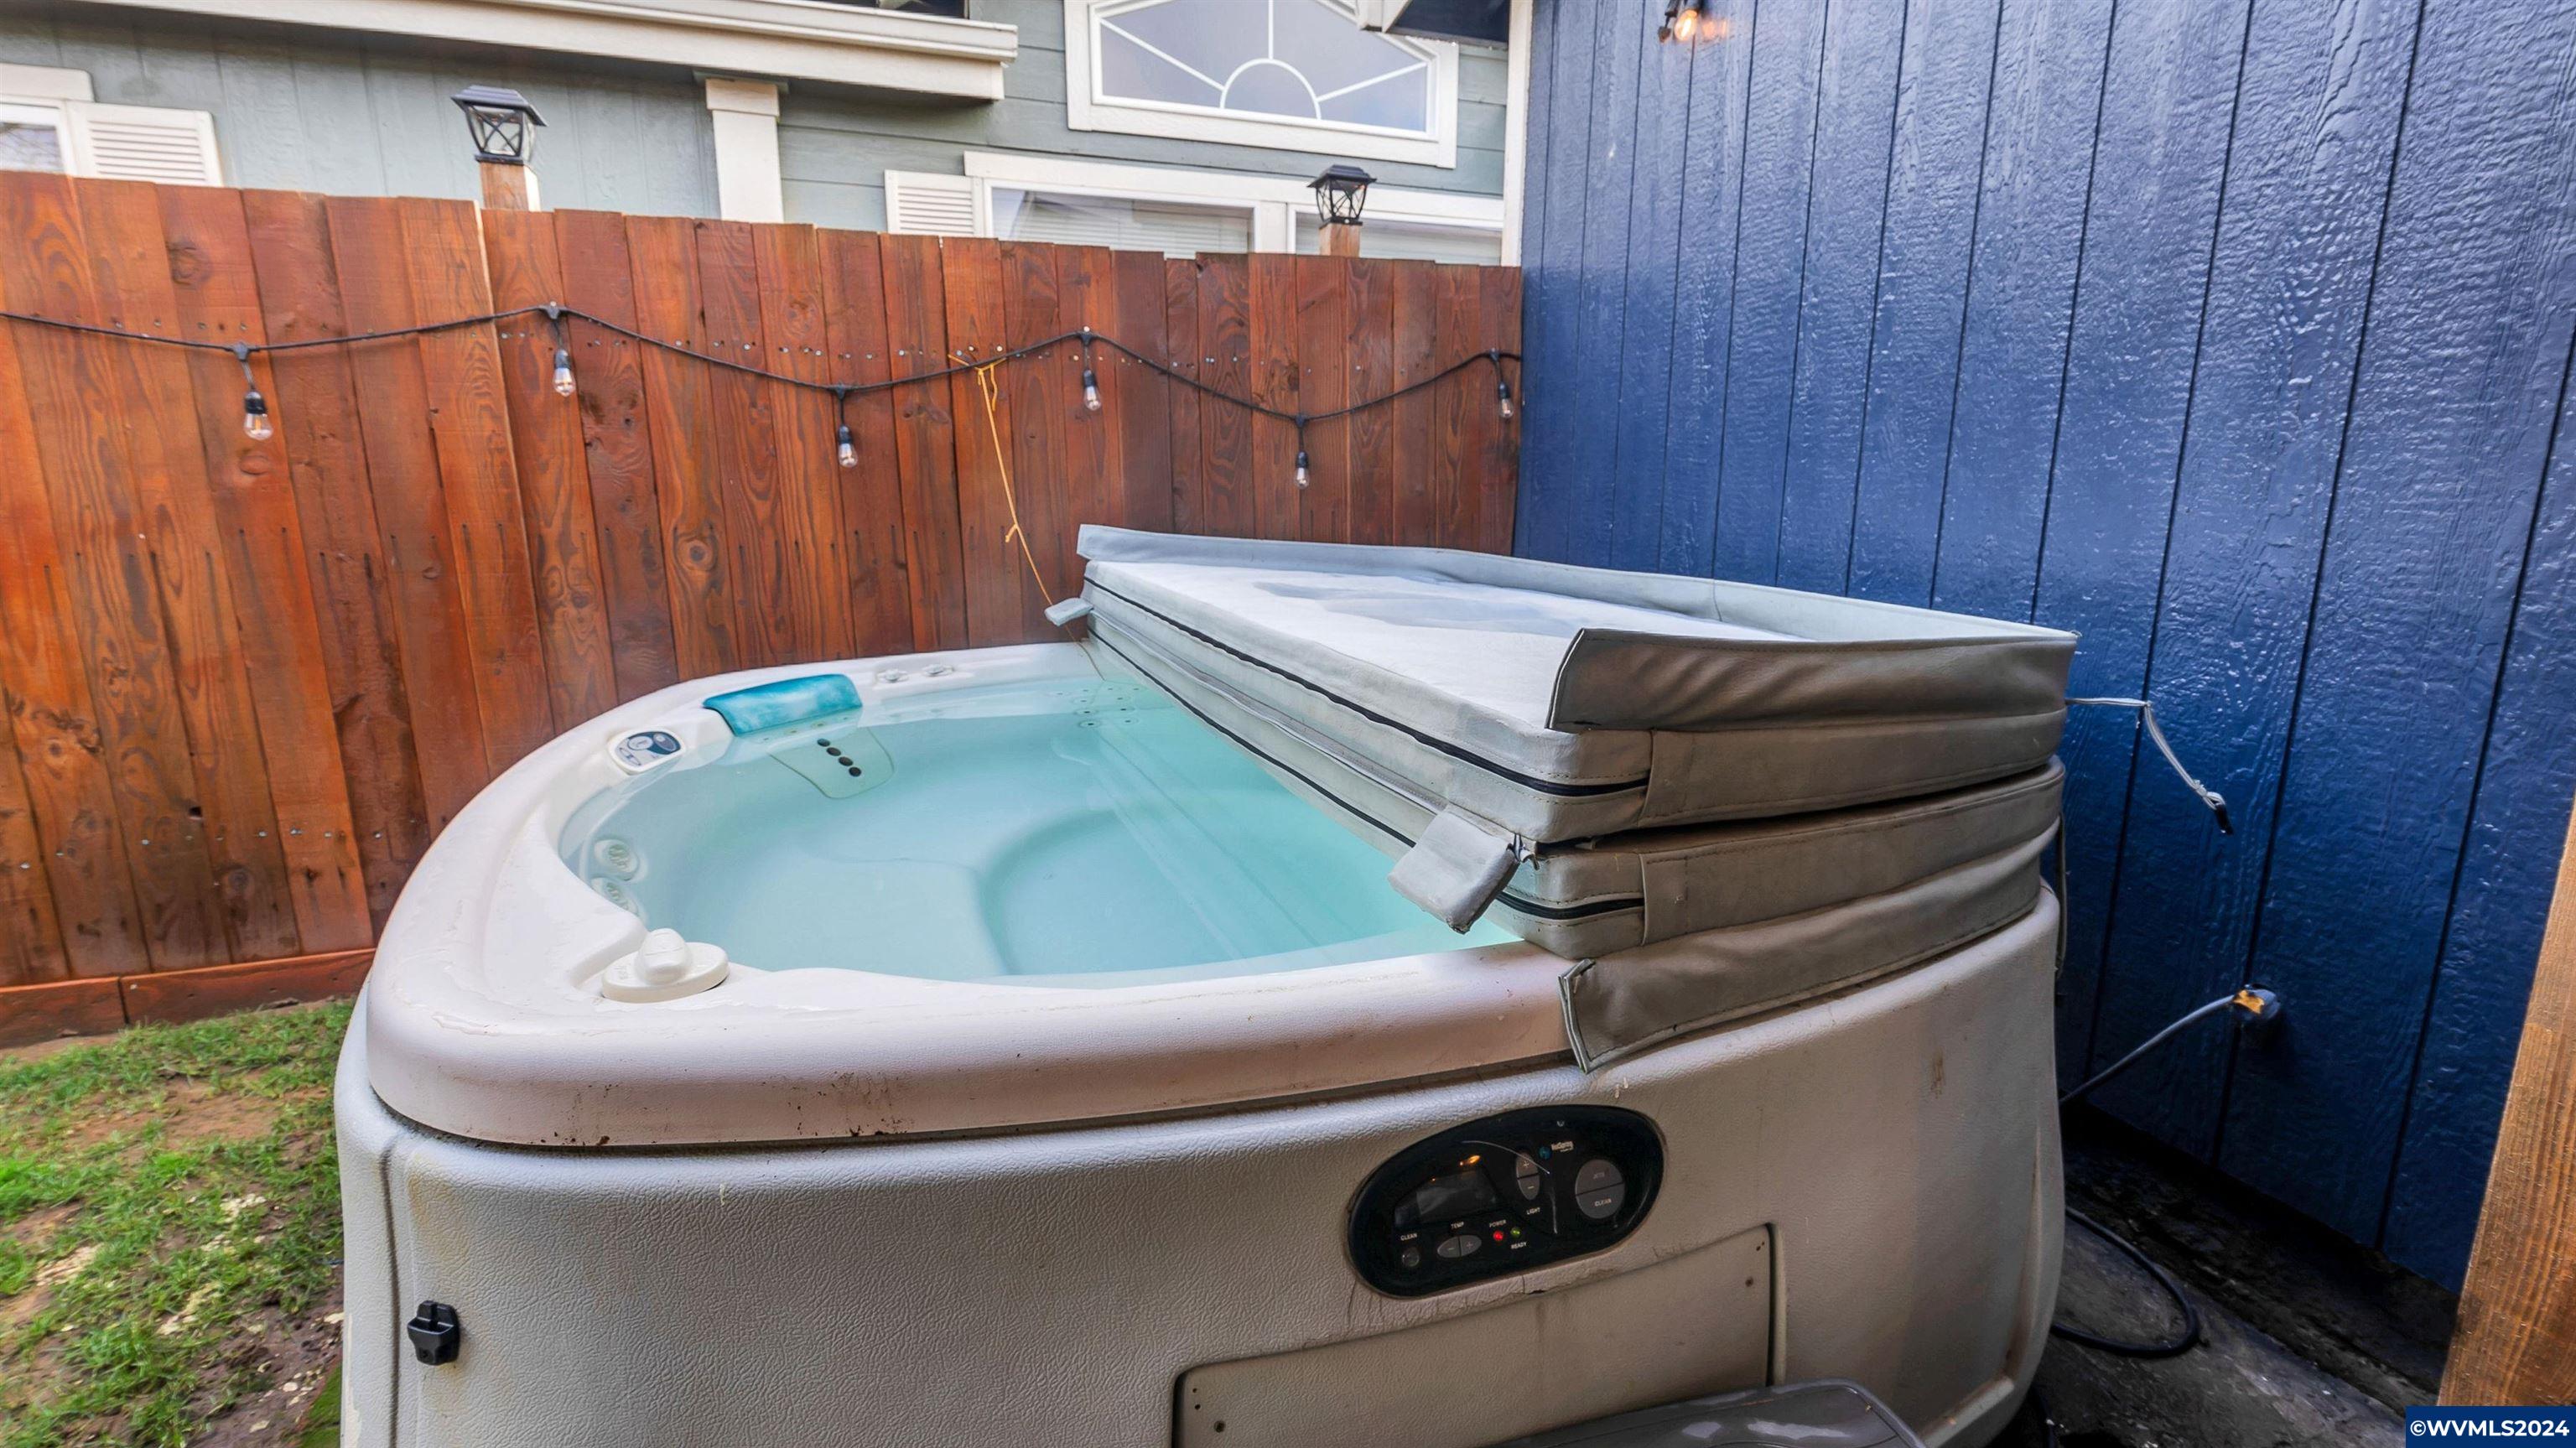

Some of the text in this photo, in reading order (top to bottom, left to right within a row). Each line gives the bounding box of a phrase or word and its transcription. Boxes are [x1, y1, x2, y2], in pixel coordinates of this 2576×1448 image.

[1526, 1207, 1540, 1215] LIGHT
[1451, 1221, 1465, 1230] TEMP
[1489, 1219, 1507, 1228] POWER
[1400, 1233, 1418, 1241] CLEAN
[1511, 1241, 1527, 1249] READY
